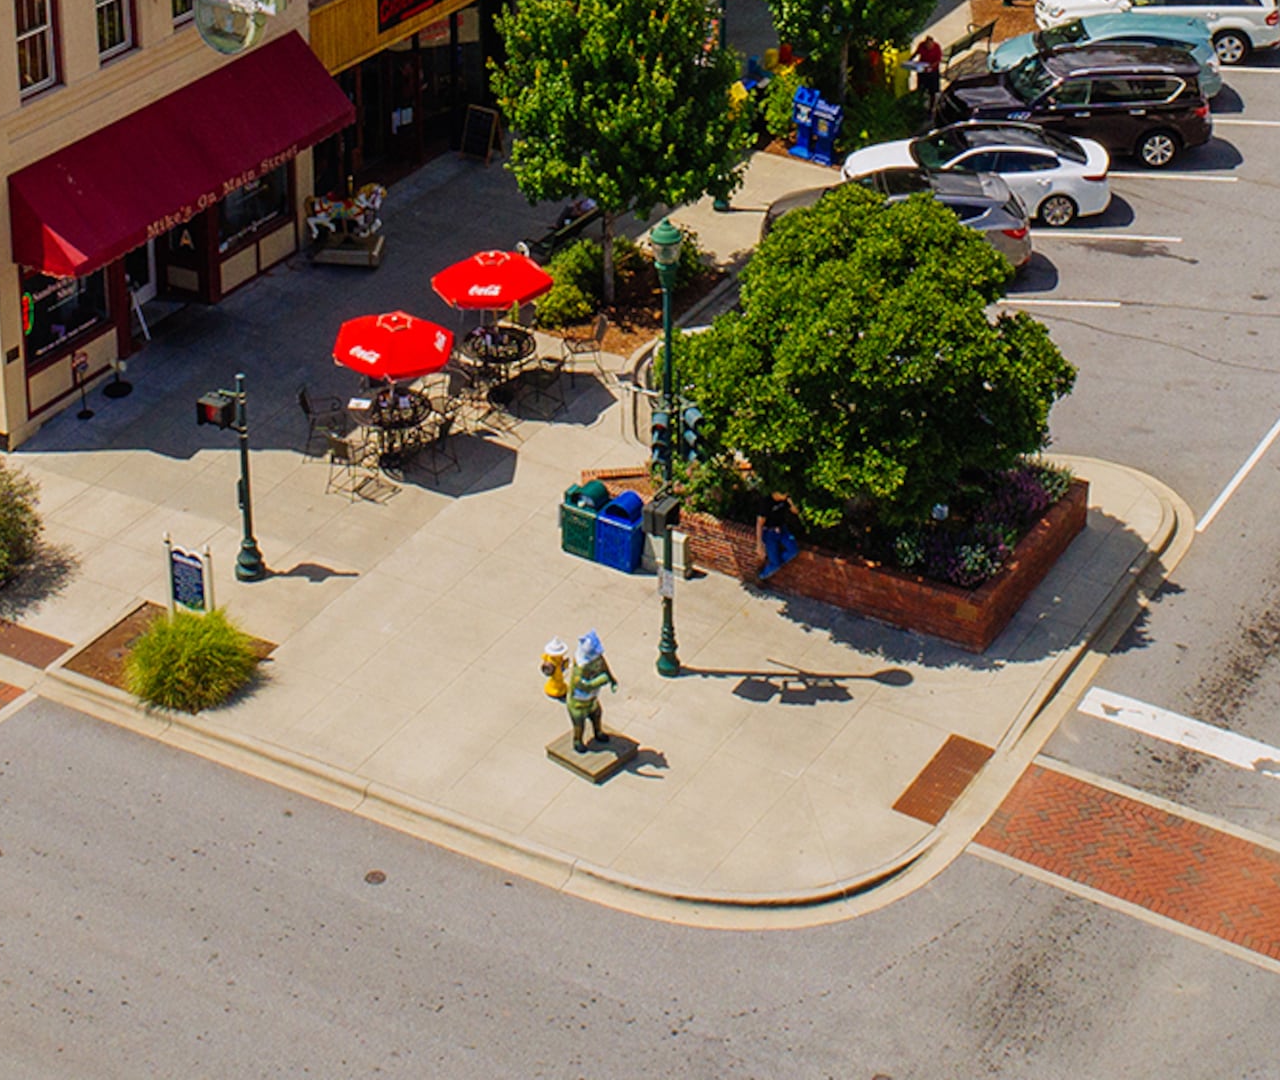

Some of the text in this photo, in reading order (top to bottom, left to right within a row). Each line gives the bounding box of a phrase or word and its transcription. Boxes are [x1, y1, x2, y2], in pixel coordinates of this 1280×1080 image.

[146, 204, 193, 239] Mike's
[223, 169, 256, 195] Main
[261, 143, 298, 173] Street
